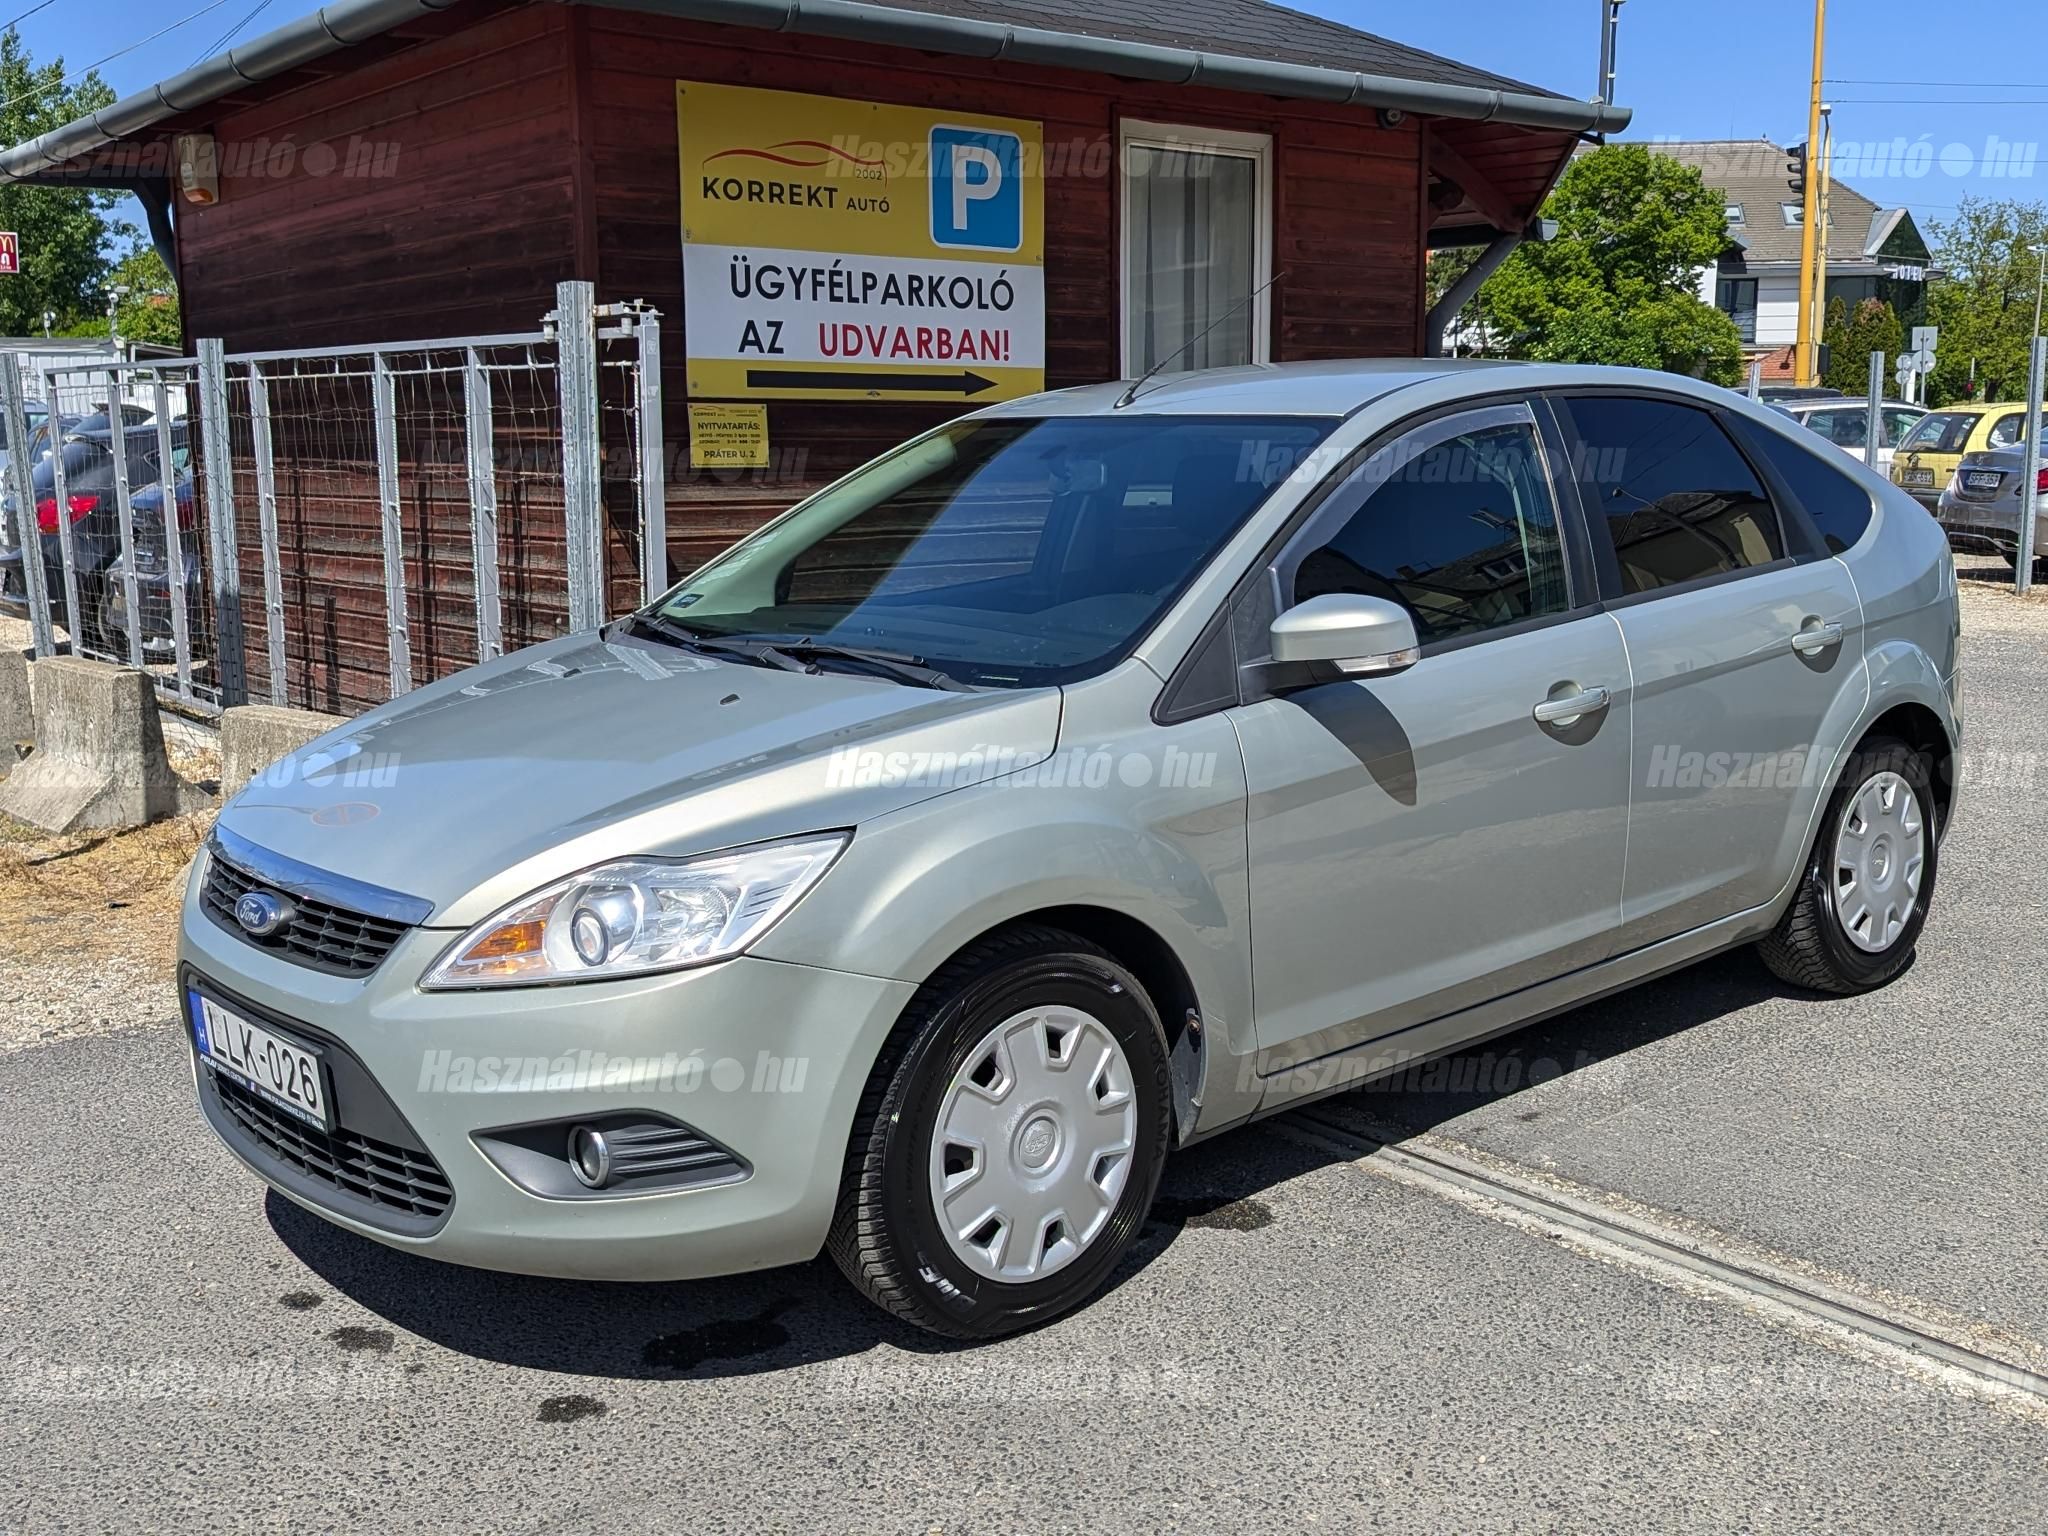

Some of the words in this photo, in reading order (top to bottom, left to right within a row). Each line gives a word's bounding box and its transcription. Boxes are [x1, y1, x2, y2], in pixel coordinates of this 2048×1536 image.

[856, 168, 882, 181] 2002
[951, 144, 1002, 231] P
[703, 177, 838, 209] KORREKT
[846, 197, 890, 214] AUTÓ
[730, 255, 1015, 311] ÜGYFÉLPARKOLÓ
[738, 319, 785, 354] AZ
[819, 322, 1010, 361] UDVARBAN!
[697, 421, 761, 431] NYITVATARTÁS:
[703, 447, 738, 459] PRÁTER
[240, 899, 262, 925] Ford
[198, 1026, 207, 1045] H
[207, 1005, 318, 1110] LLK-026
